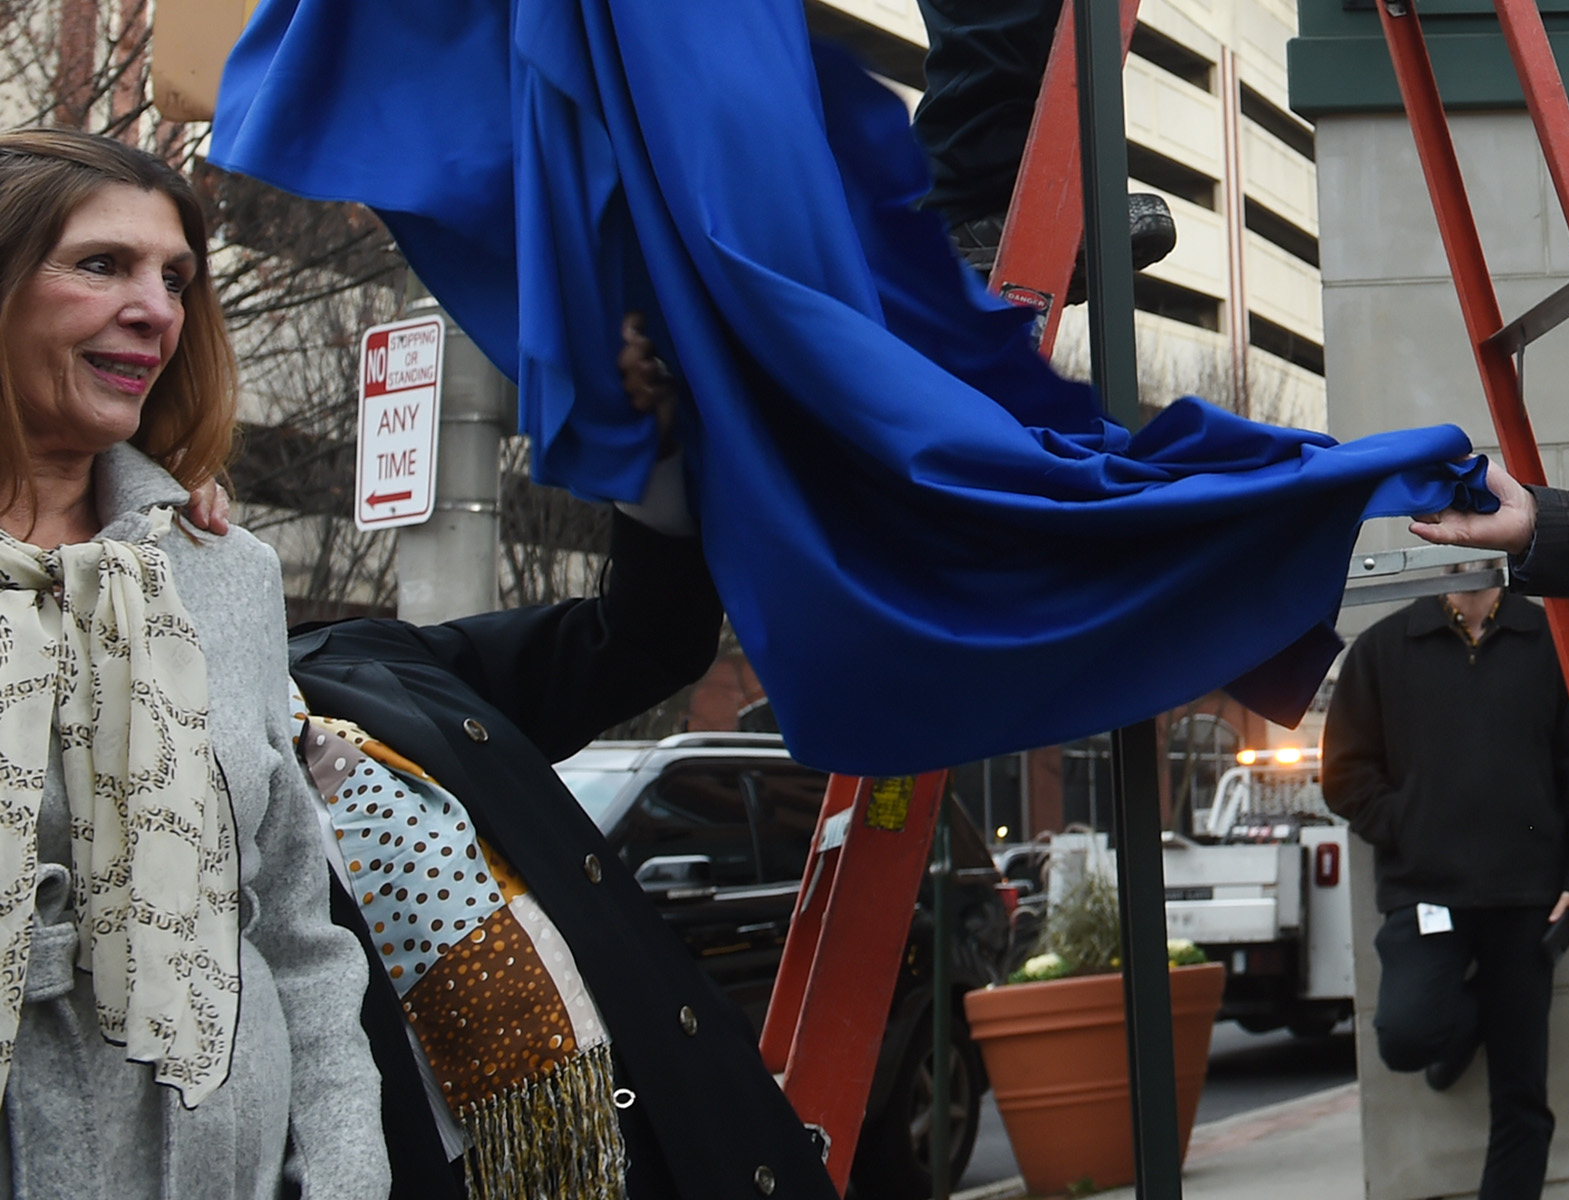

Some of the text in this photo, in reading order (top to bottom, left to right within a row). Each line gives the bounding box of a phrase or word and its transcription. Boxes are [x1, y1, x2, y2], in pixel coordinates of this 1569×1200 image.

[1008, 293, 1045, 307] DANGER
[389, 329, 436, 351] STOPPING
[366, 347, 386, 385] NO
[404, 351, 419, 366] OR
[387, 365, 434, 388] STANDING
[377, 404, 420, 437] ANY
[376, 449, 417, 481] TIME
